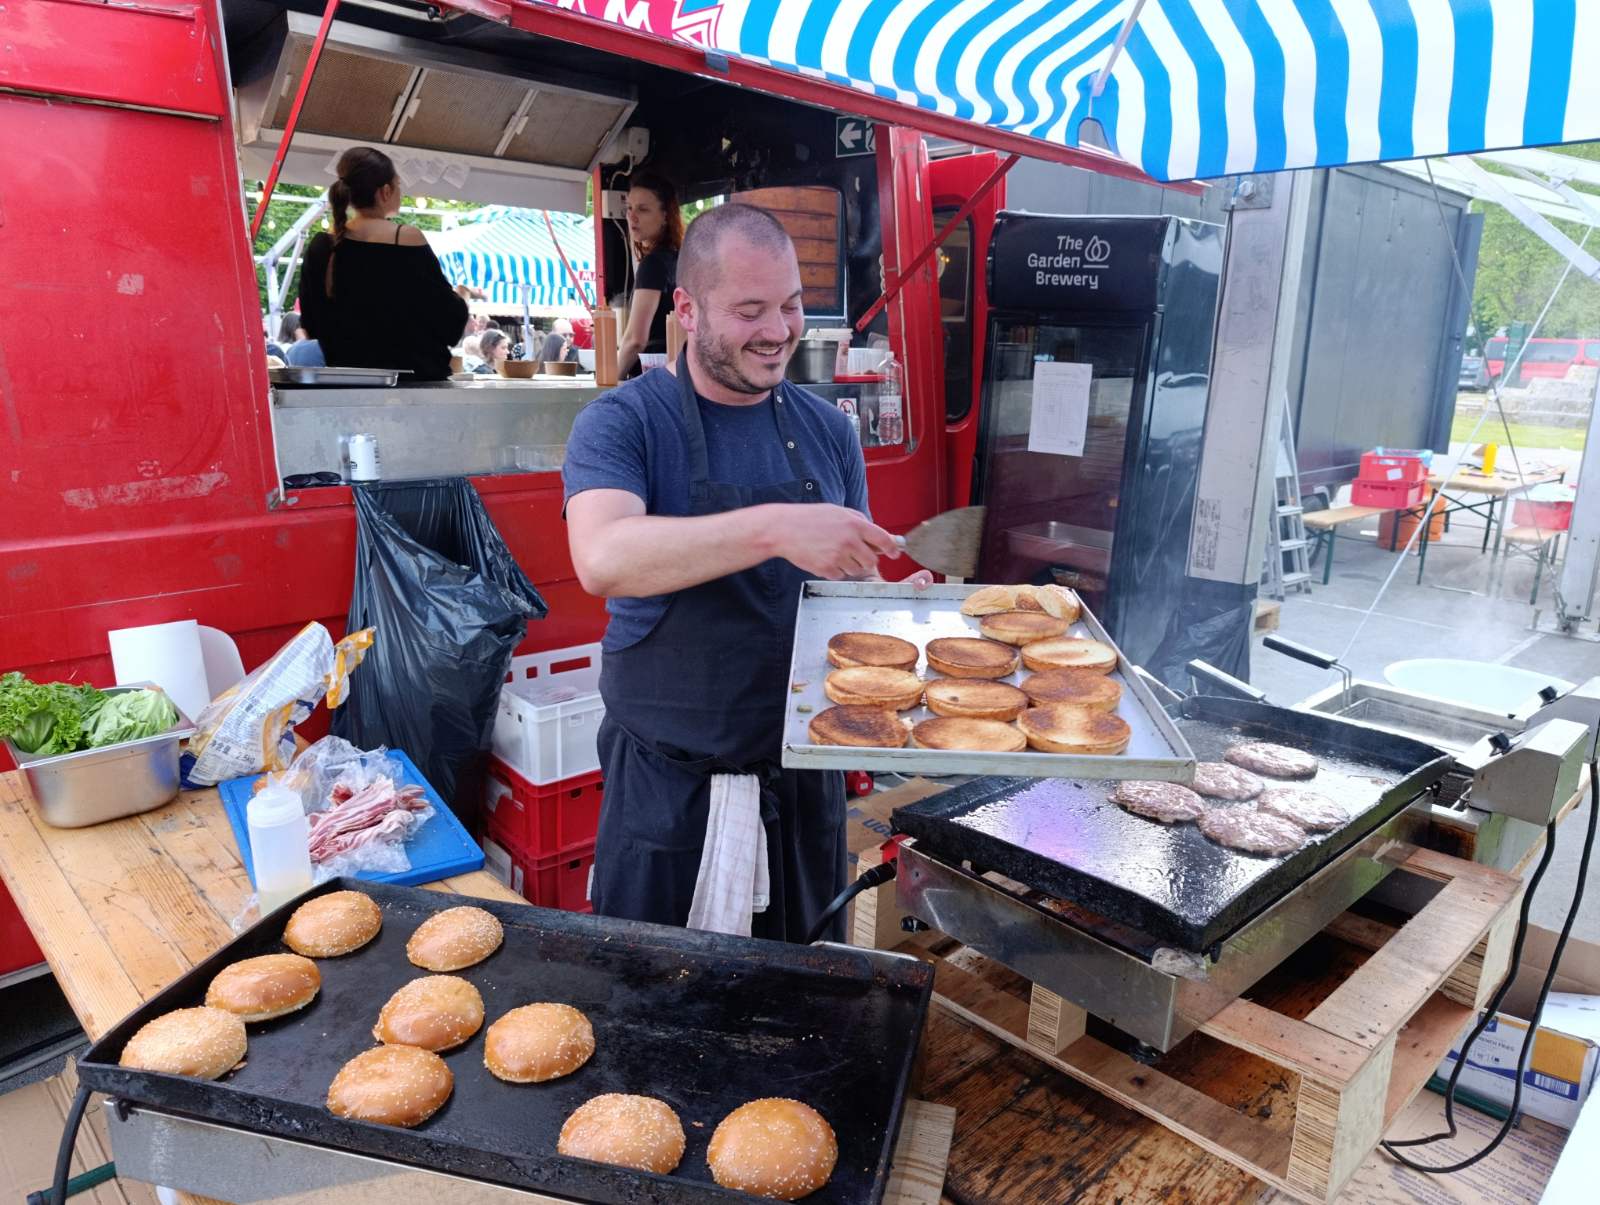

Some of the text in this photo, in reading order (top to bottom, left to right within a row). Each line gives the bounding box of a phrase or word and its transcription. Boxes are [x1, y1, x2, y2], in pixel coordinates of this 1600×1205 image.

[1057, 235, 1083, 250] The
[1027, 252, 1080, 268] Garden
[1036, 271, 1098, 289] Brewery
